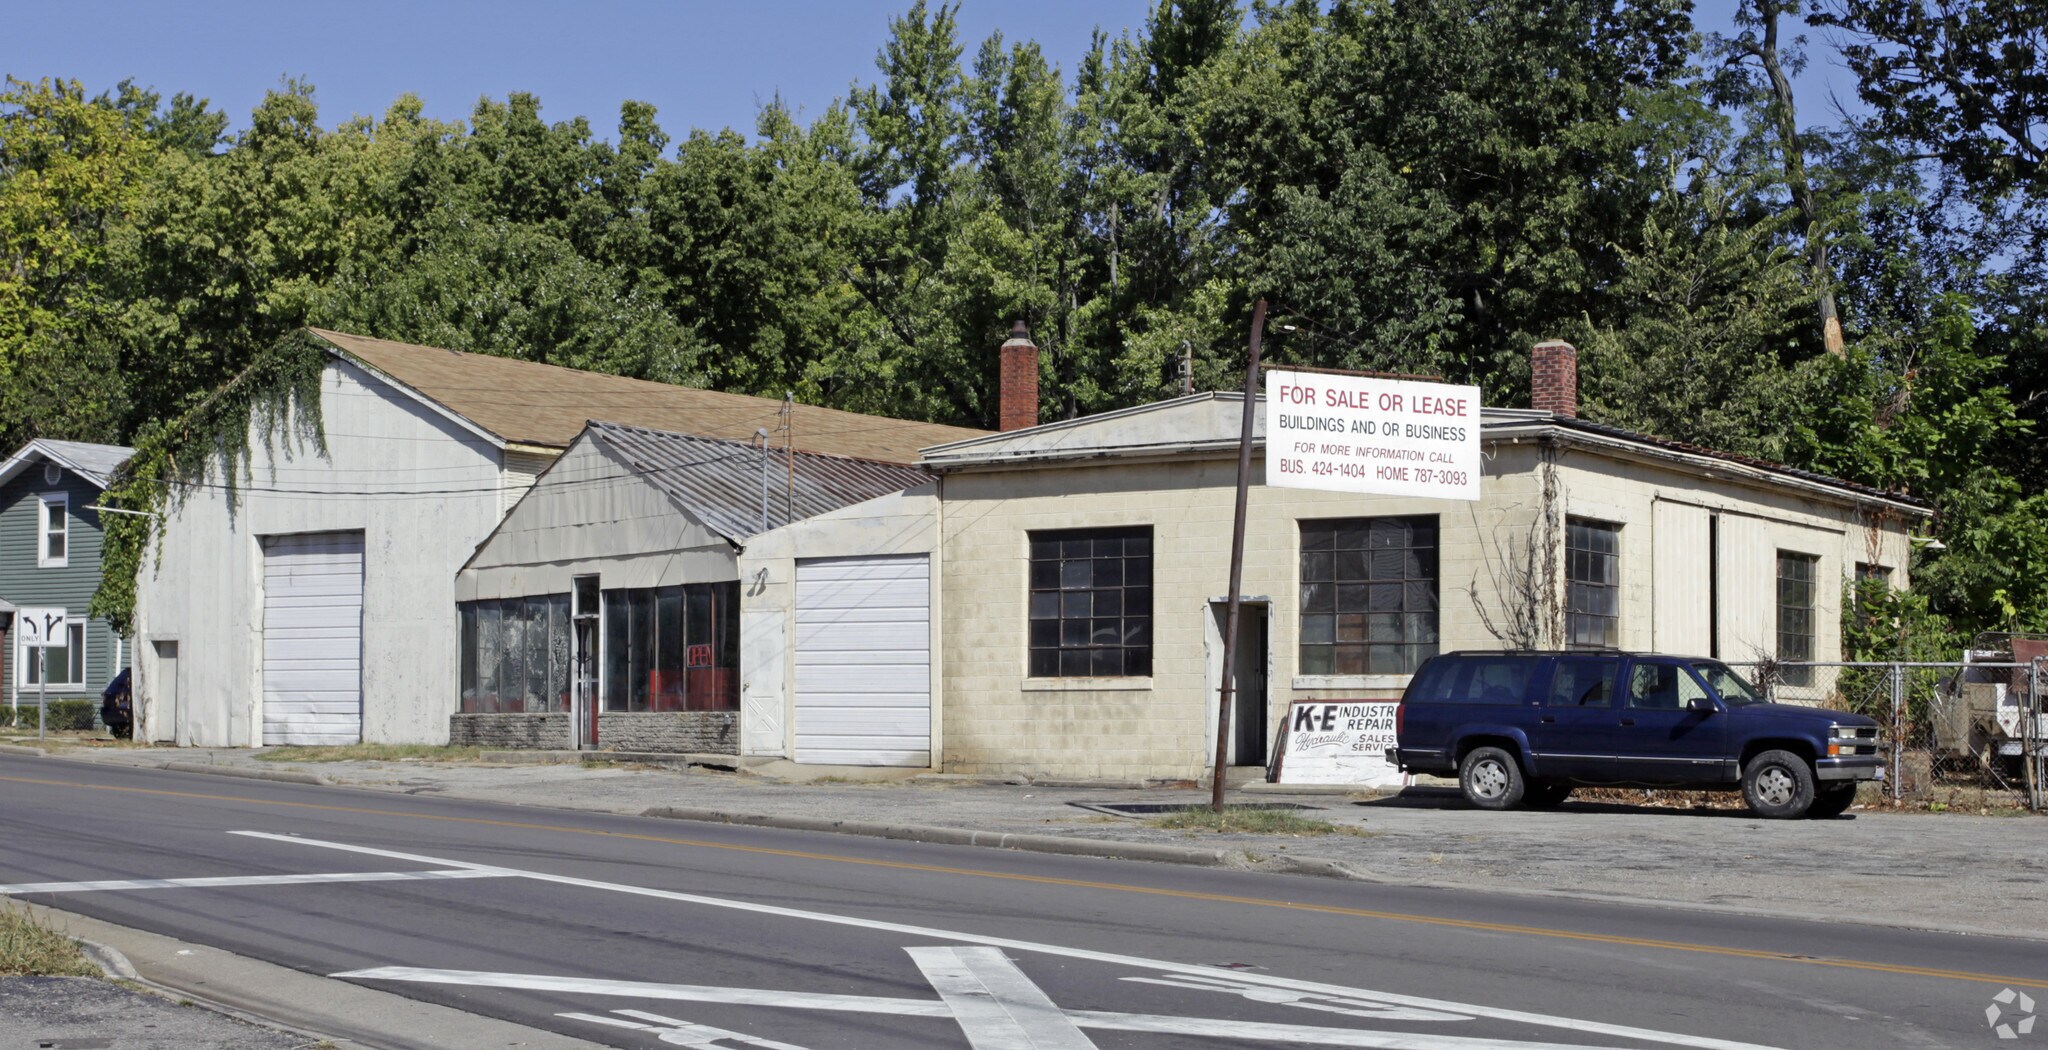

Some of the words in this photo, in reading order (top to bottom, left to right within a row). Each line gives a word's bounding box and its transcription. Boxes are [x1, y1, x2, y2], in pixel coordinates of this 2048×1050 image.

[1280, 385, 1316, 405] FOR
[1325, 389, 1370, 409] SALE
[1378, 393, 1403, 412] OR
[1412, 396, 1468, 417] LEASE
[1279, 414, 1345, 432] BUILDINGS
[1350, 420, 1377, 435] AND
[1381, 422, 1400, 437] OR
[1405, 424, 1467, 442] BUSINESS
[1294, 442, 1316, 454] FOR
[1320, 444, 1351, 457] MORE
[1355, 447, 1425, 462] INFORMATION
[1429, 452, 1455, 465] CALL
[1280, 458, 1308, 475] BUS.
[1311, 462, 1366, 479] 424-1404
[1376, 466, 1410, 482] HOME
[1414, 469, 1467, 486] 787-3093
[1294, 705, 1338, 732] K-E
[1339, 705, 1397, 718] INDUSTR
[1347, 719, 1393, 730] REPAIR
[1295, 732, 1351, 752] Hydraulic
[1359, 734, 1395, 743] SALES
